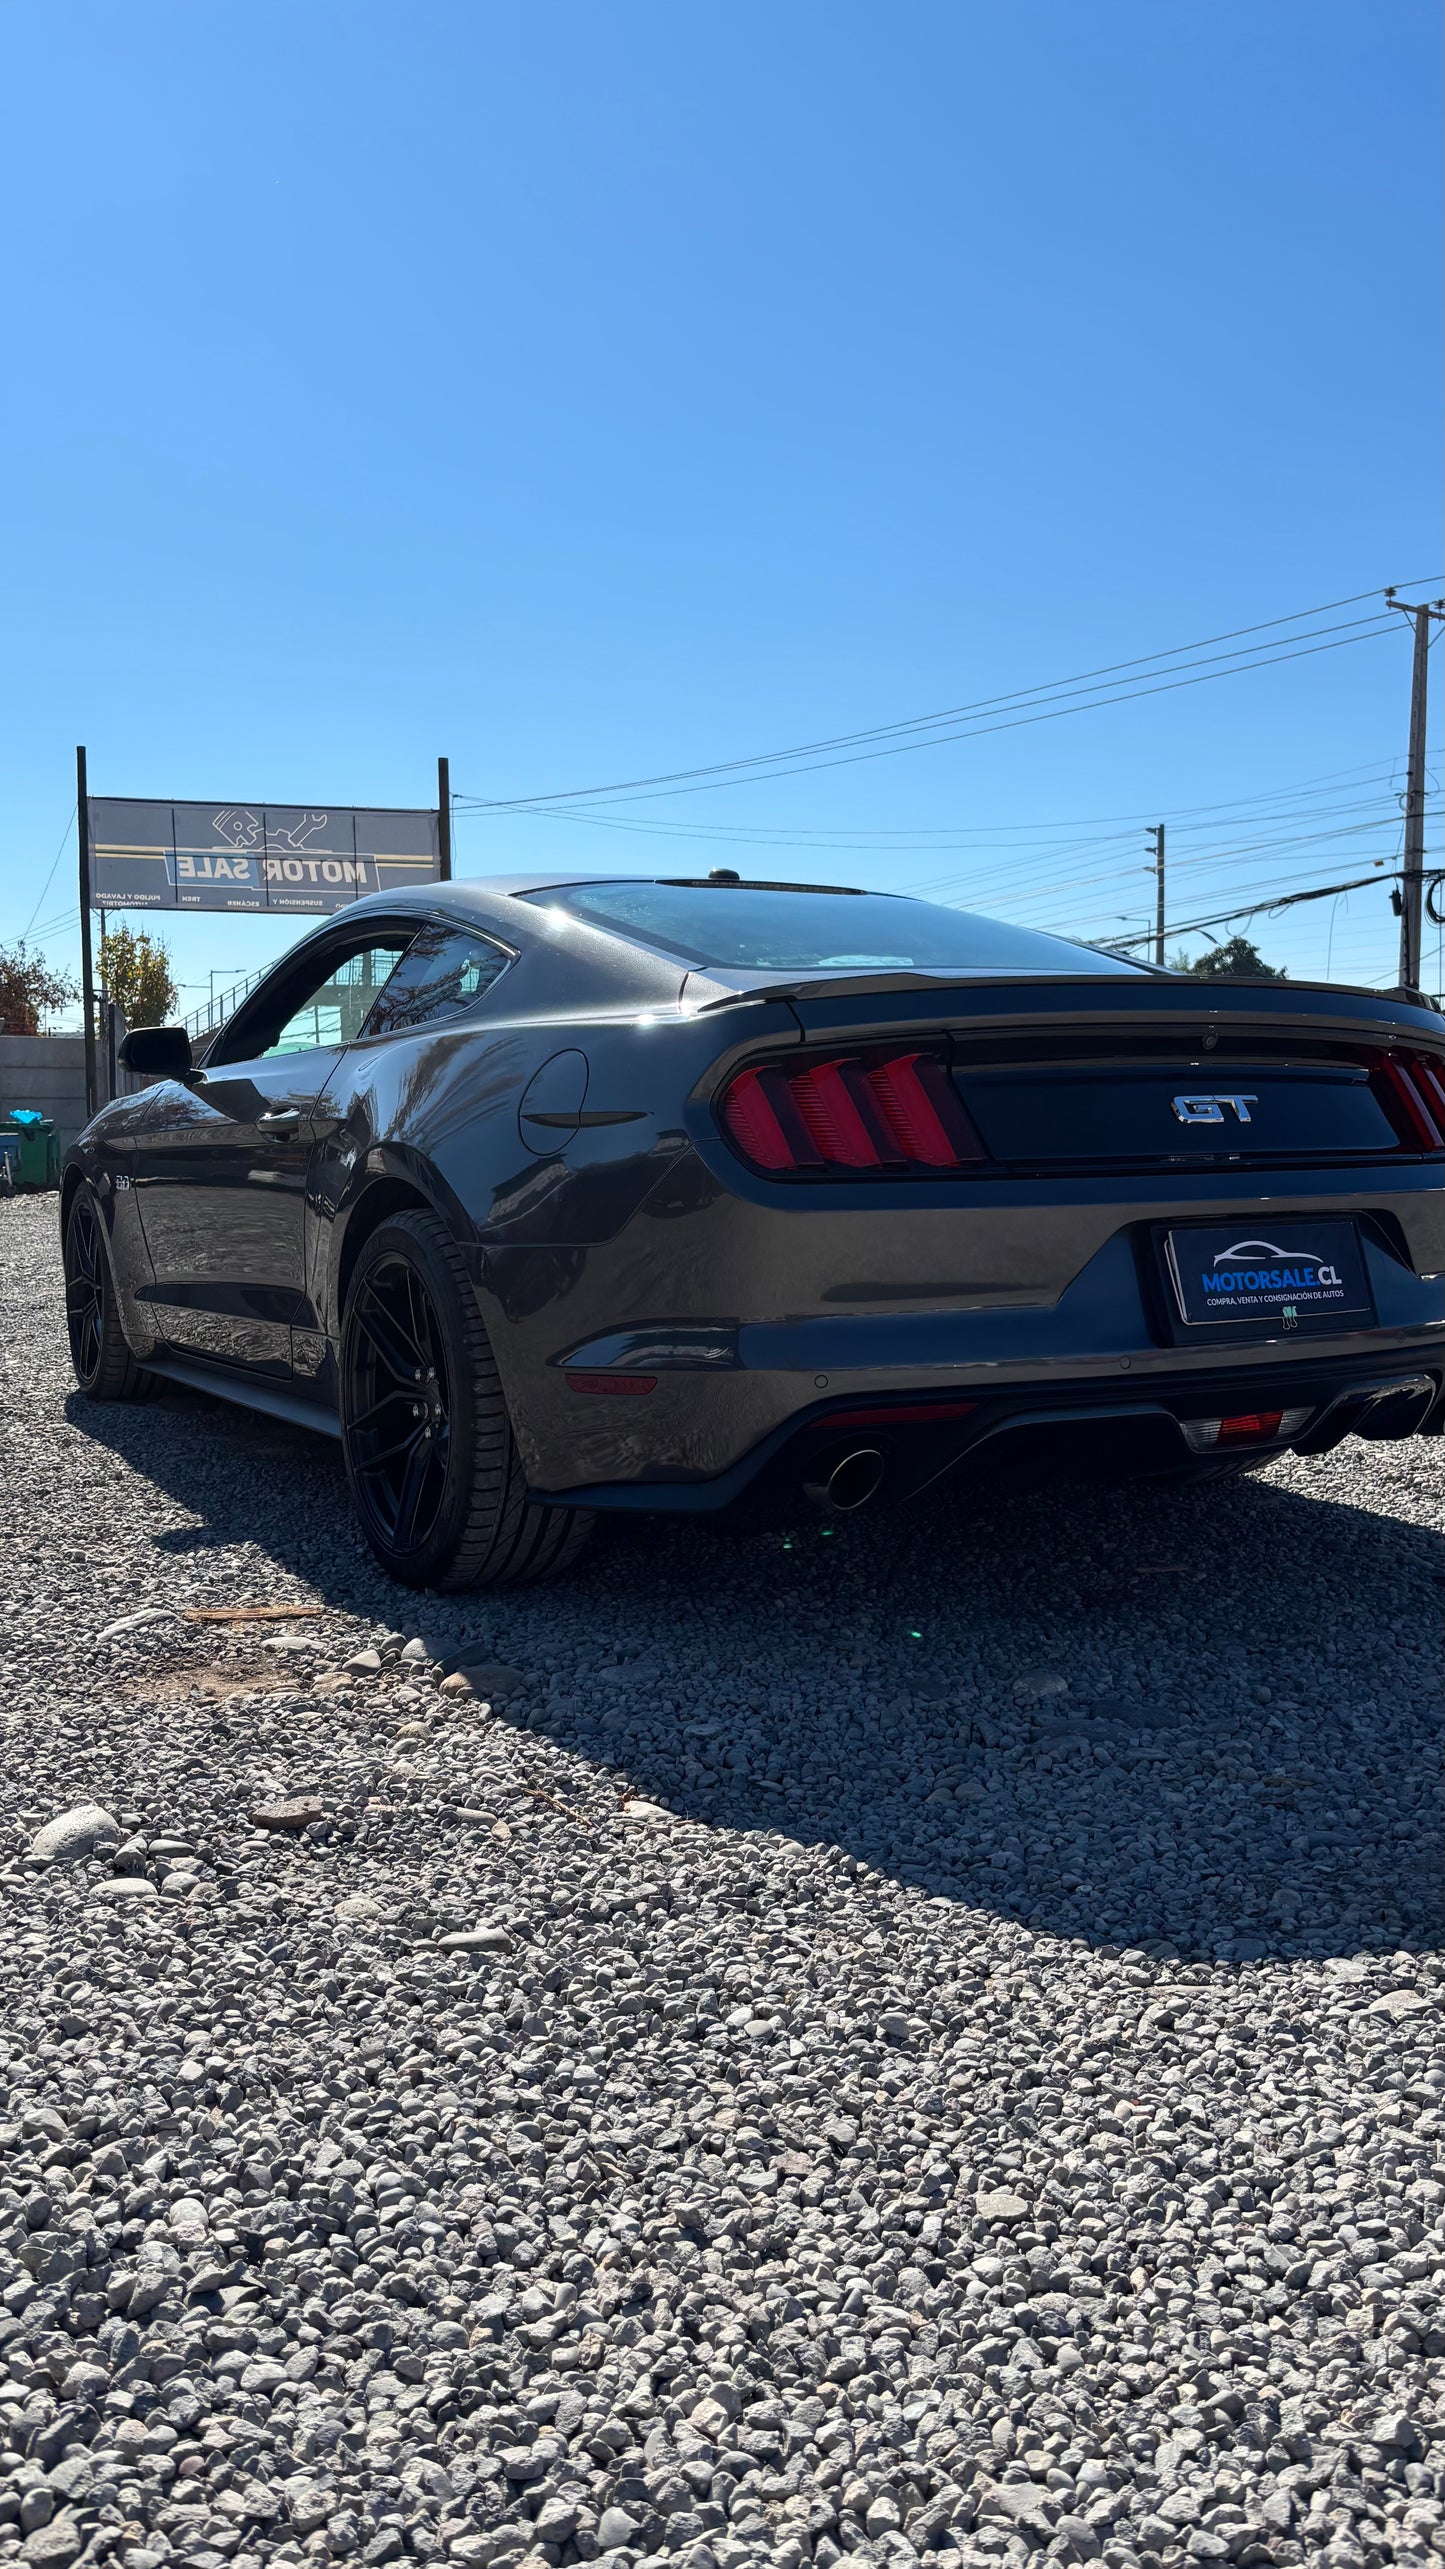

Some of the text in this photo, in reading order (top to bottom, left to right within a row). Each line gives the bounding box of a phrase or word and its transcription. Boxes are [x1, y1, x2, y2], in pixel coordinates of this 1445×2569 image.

[1171, 1095, 1258, 1123] GT
[1202, 1266, 1342, 1292] MOTORSALE.CL
[1206, 1289, 1344, 1307] COMPRA, VENTA Y CONSIGNACIÓN DE AUTOS
